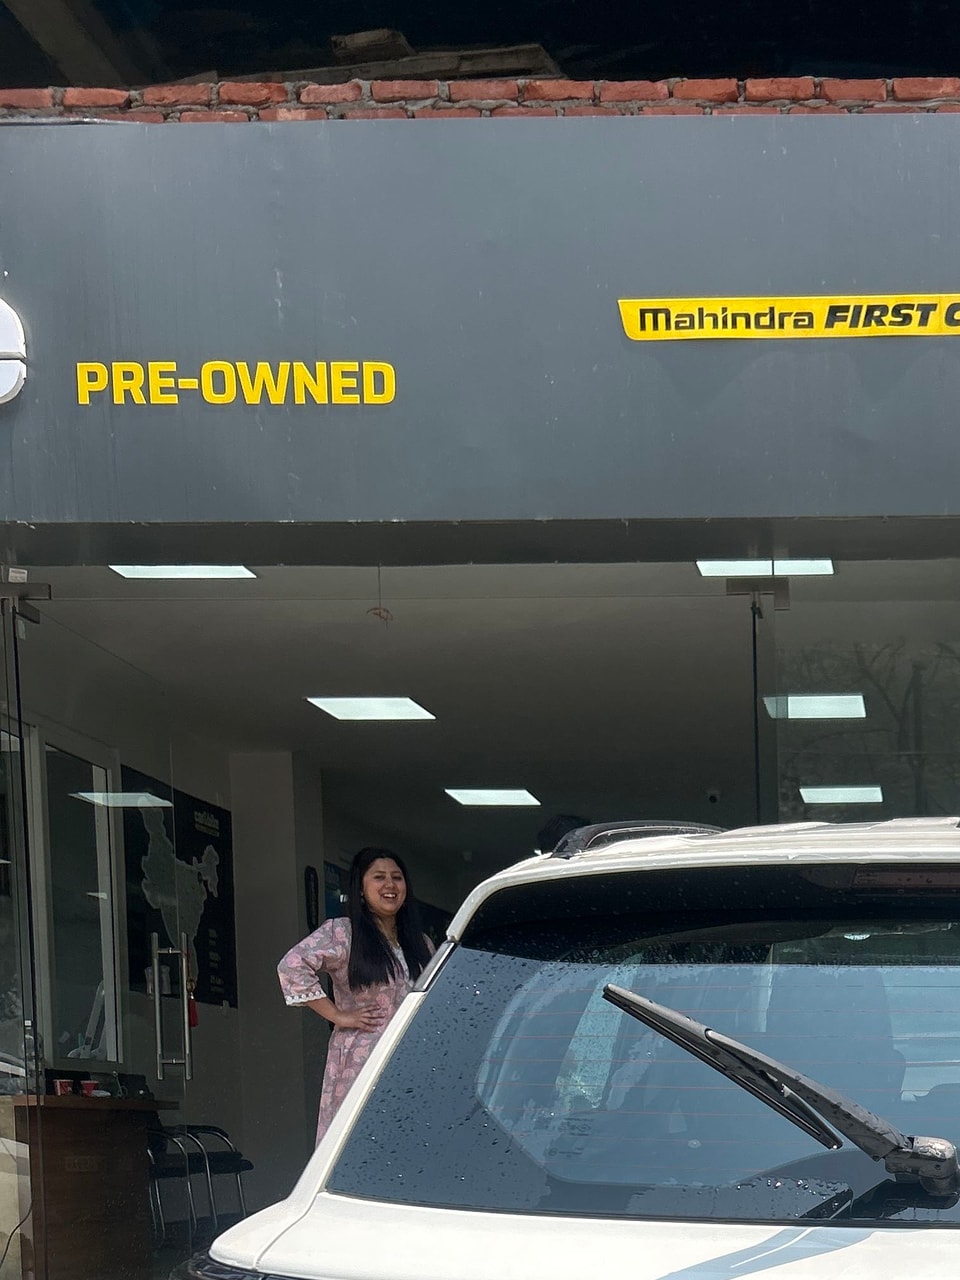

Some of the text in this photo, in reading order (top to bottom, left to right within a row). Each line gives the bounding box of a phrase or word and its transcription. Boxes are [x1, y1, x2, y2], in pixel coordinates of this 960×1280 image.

[638, 305, 815, 332] Mahindra
[824, 302, 938, 329] FIRST
[76, 360, 397, 405] PRE-OWNED
